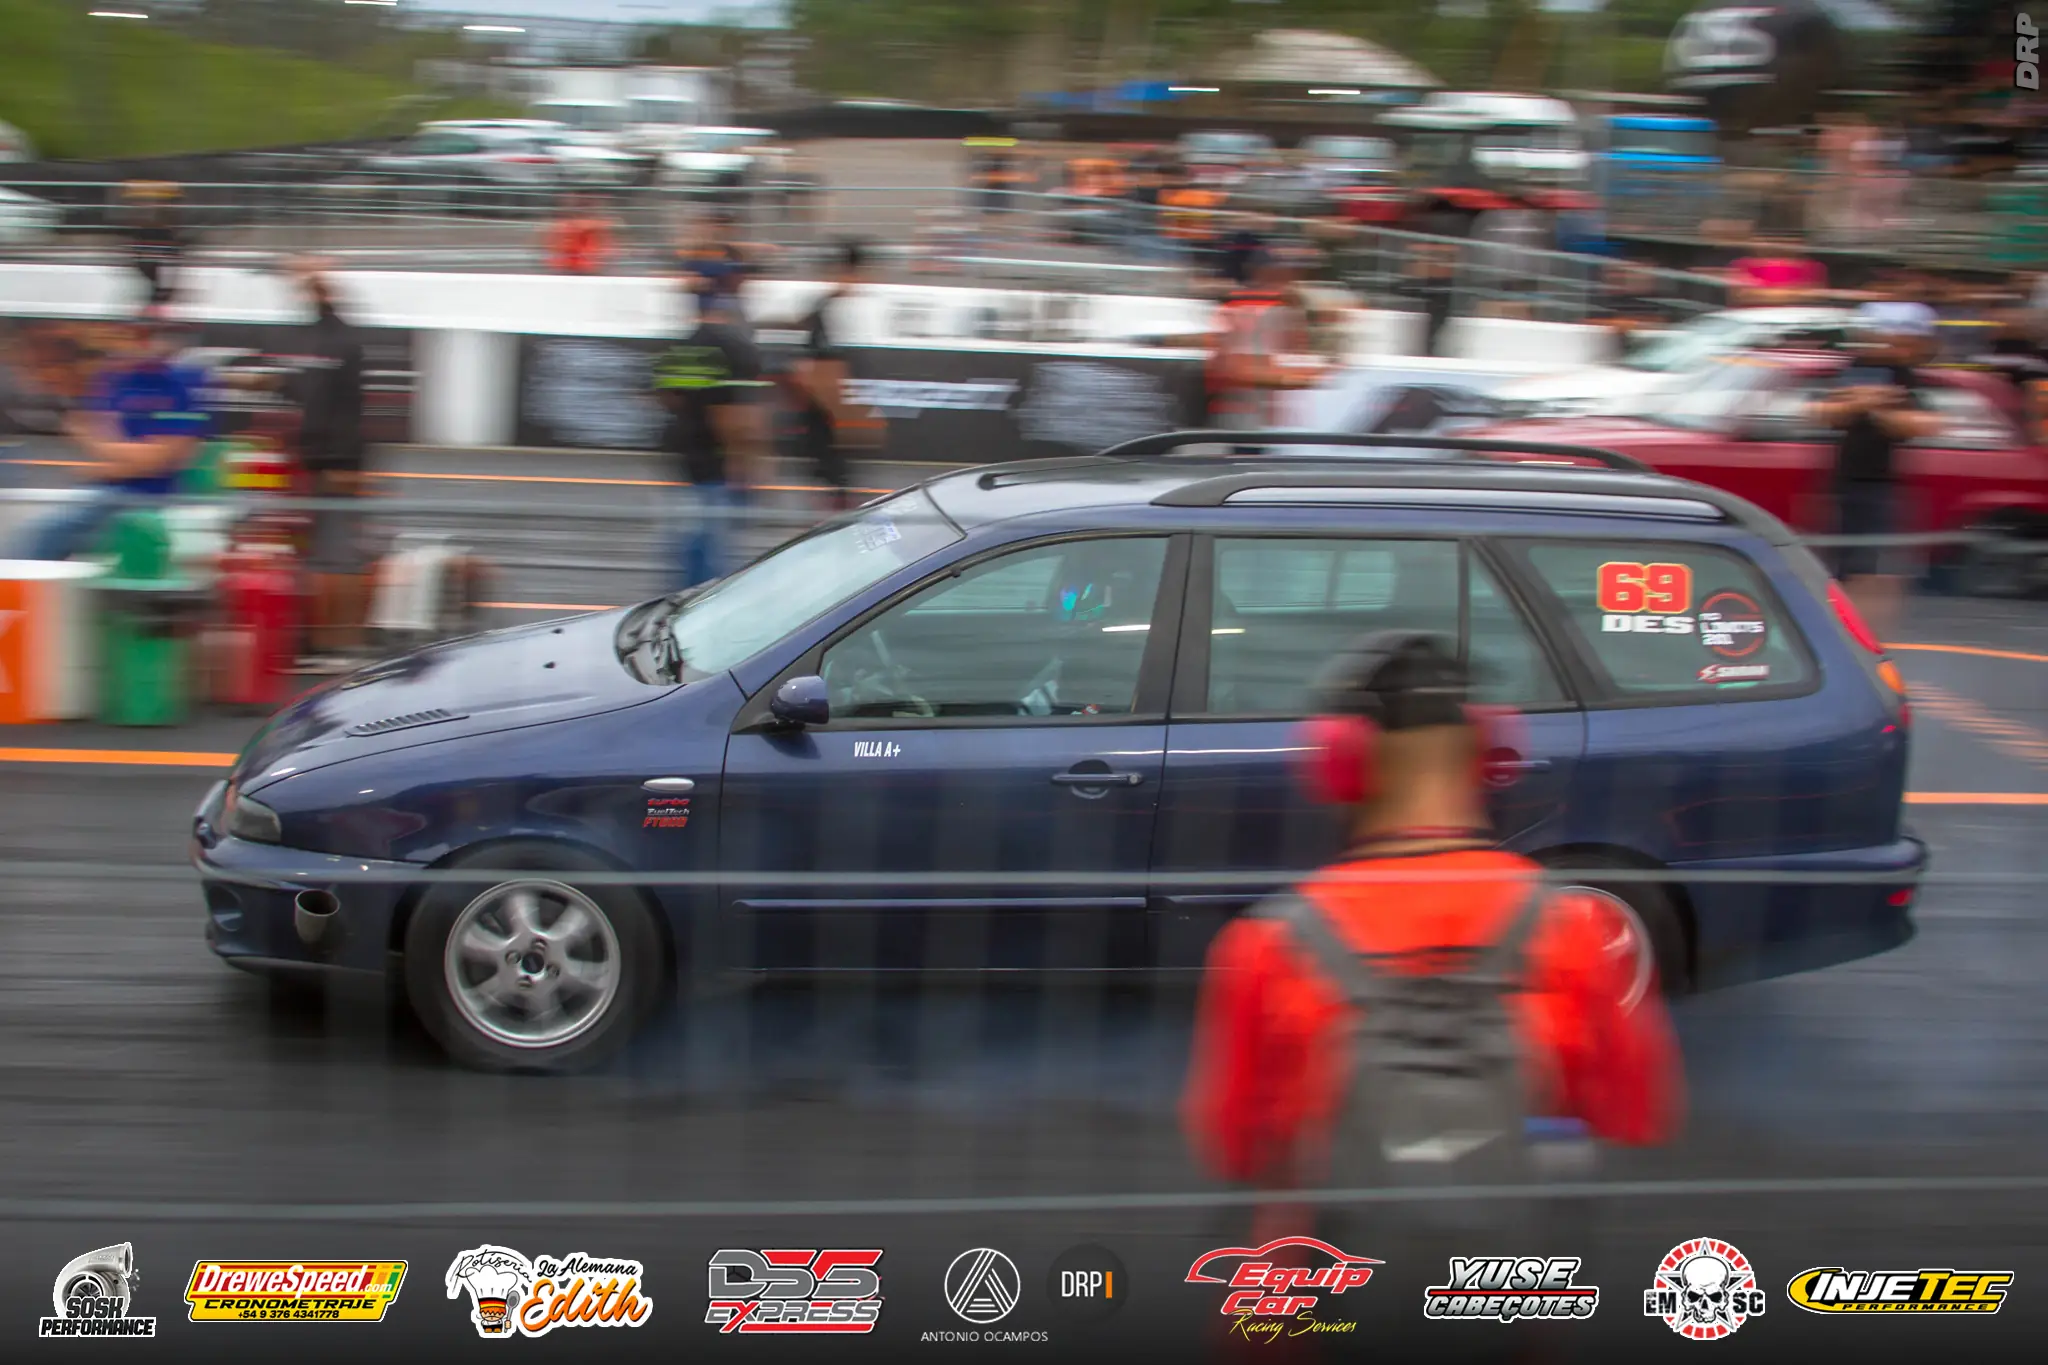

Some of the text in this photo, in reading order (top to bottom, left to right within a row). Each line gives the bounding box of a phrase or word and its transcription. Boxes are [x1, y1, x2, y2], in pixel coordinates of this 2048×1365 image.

[1597, 562, 1692, 613] 69
[1601, 614, 1696, 634] DES
[854, 742, 882, 757] VILLA
